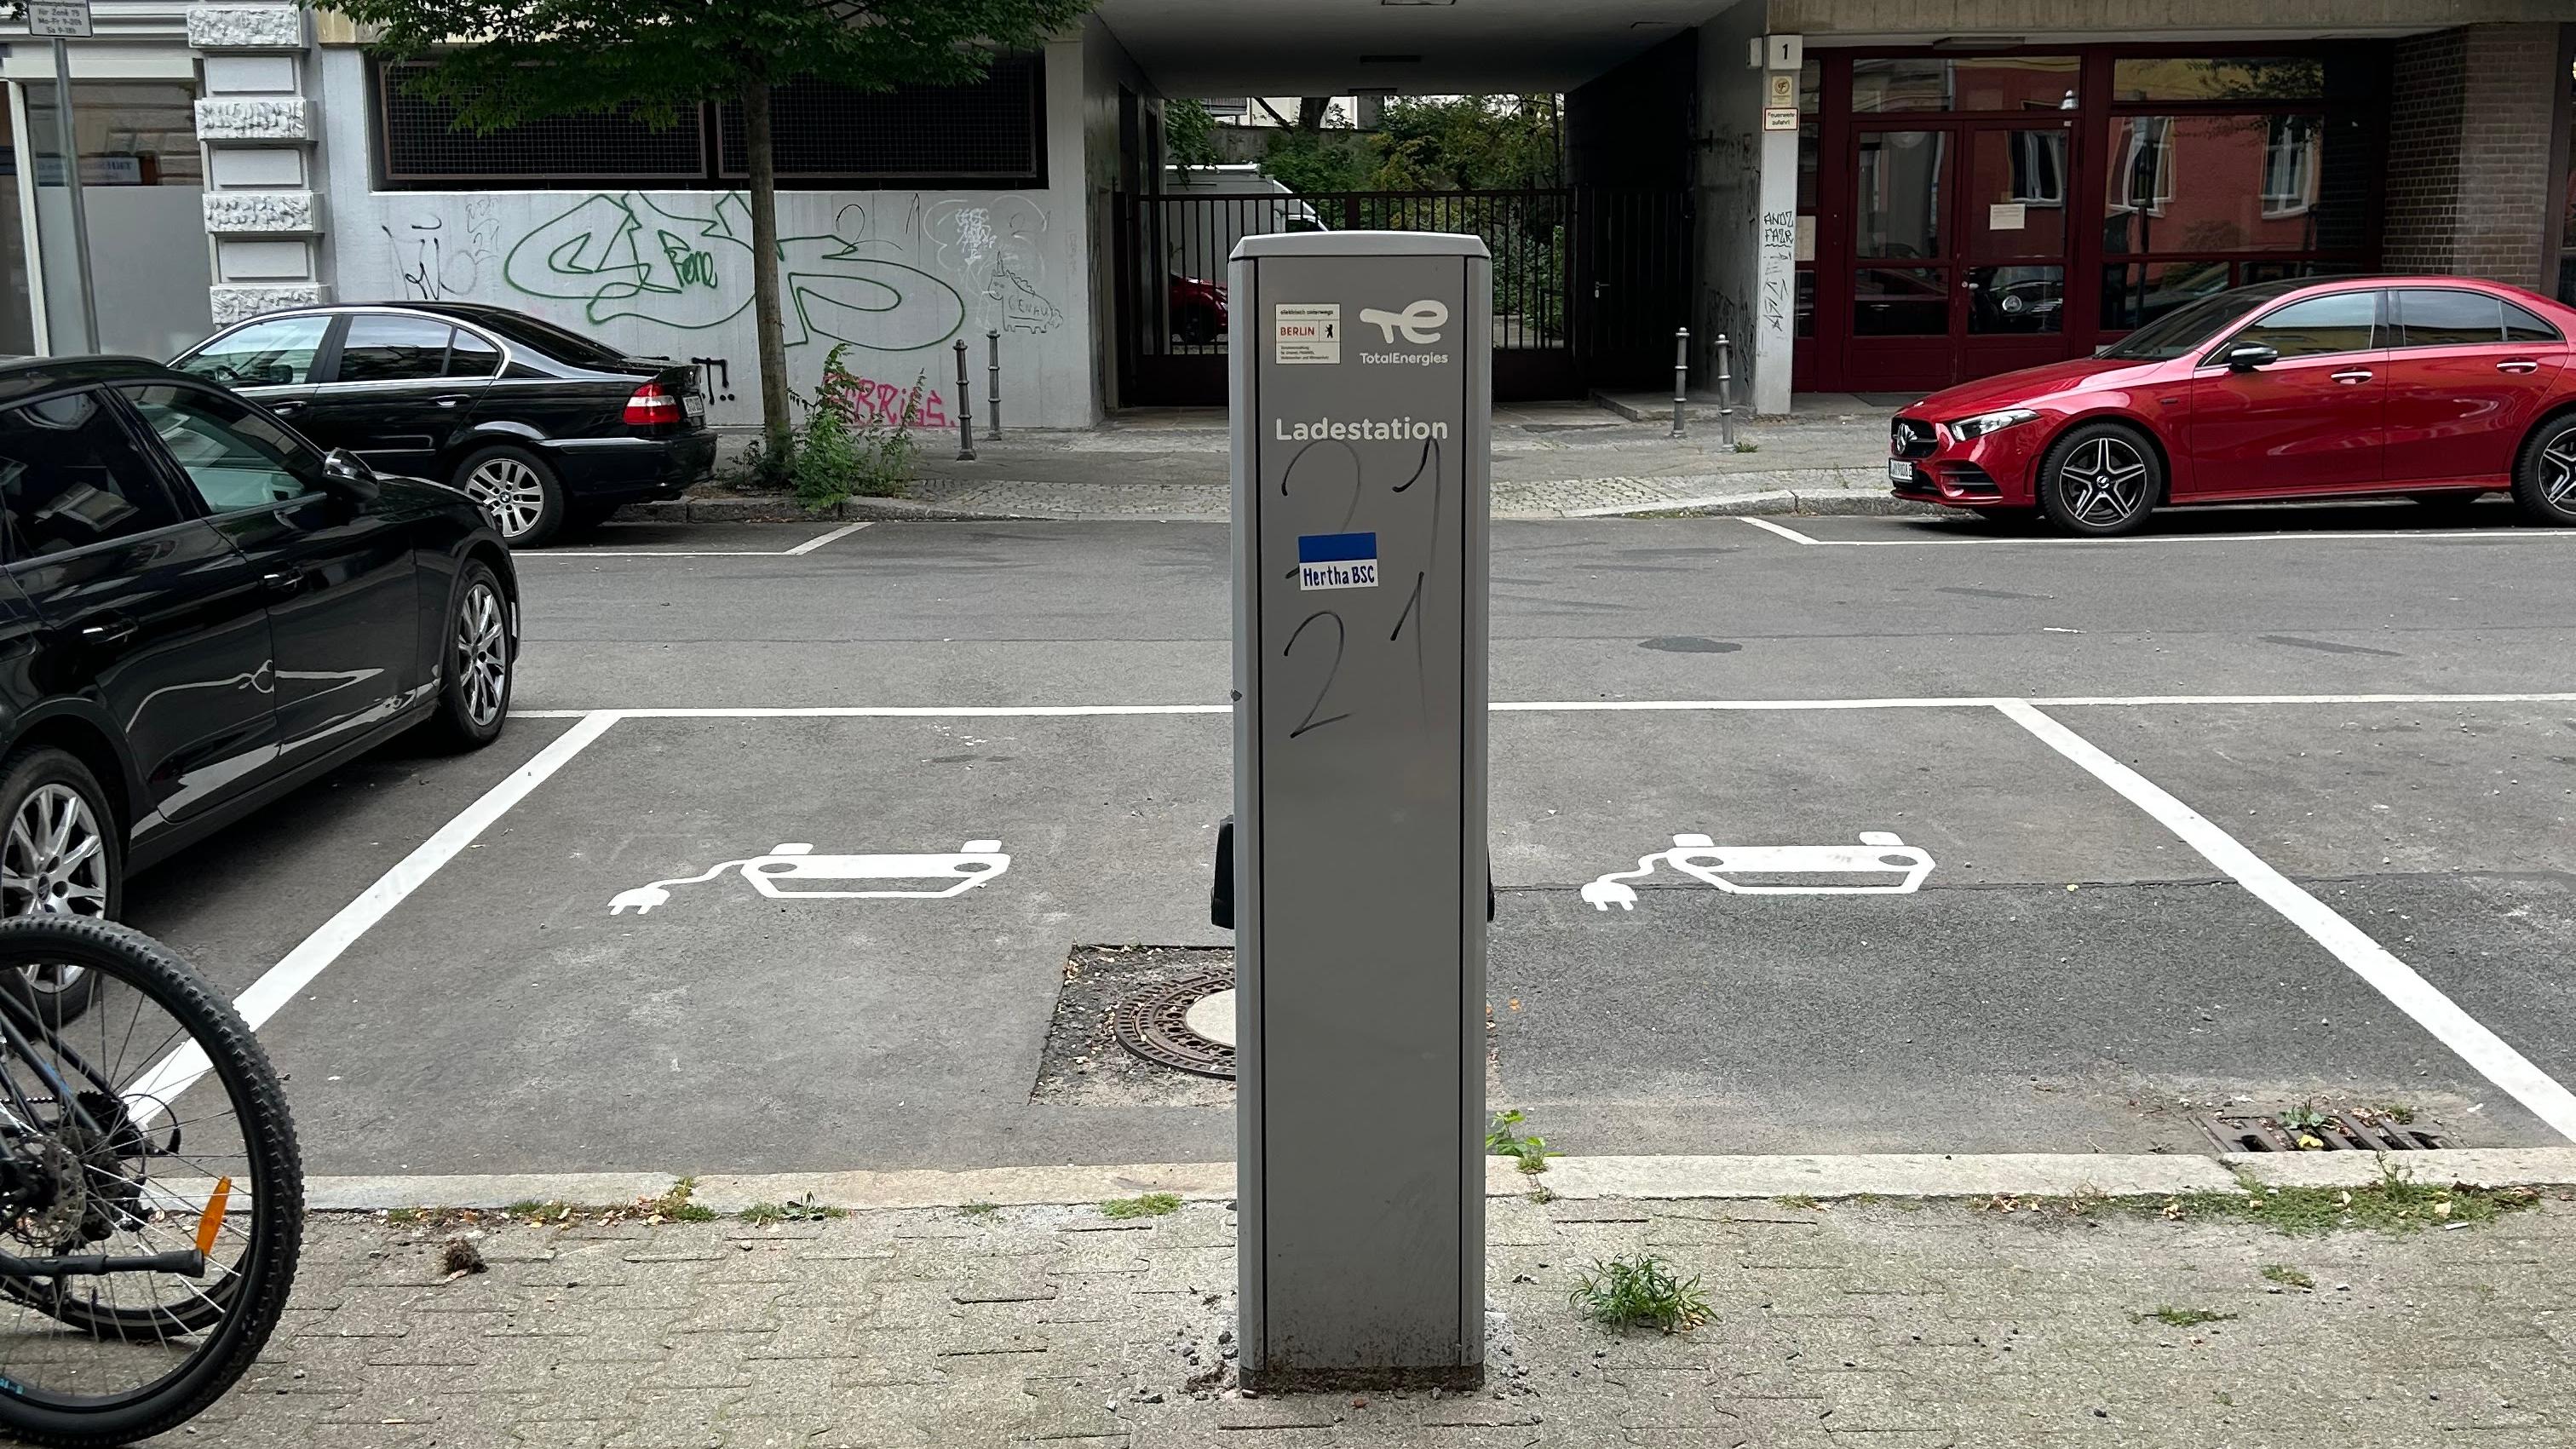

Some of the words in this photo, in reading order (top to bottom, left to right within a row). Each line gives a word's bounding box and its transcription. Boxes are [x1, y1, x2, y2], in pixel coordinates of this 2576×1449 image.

[1782, 43, 1788, 60] 1
[1279, 326, 1315, 336] BERLIN
[1360, 352, 1448, 366] TotalEnergies
[1276, 417, 1448, 440] Ladestation
[1303, 566, 1350, 586] Hertha
[1351, 565, 1375, 584] BSC
